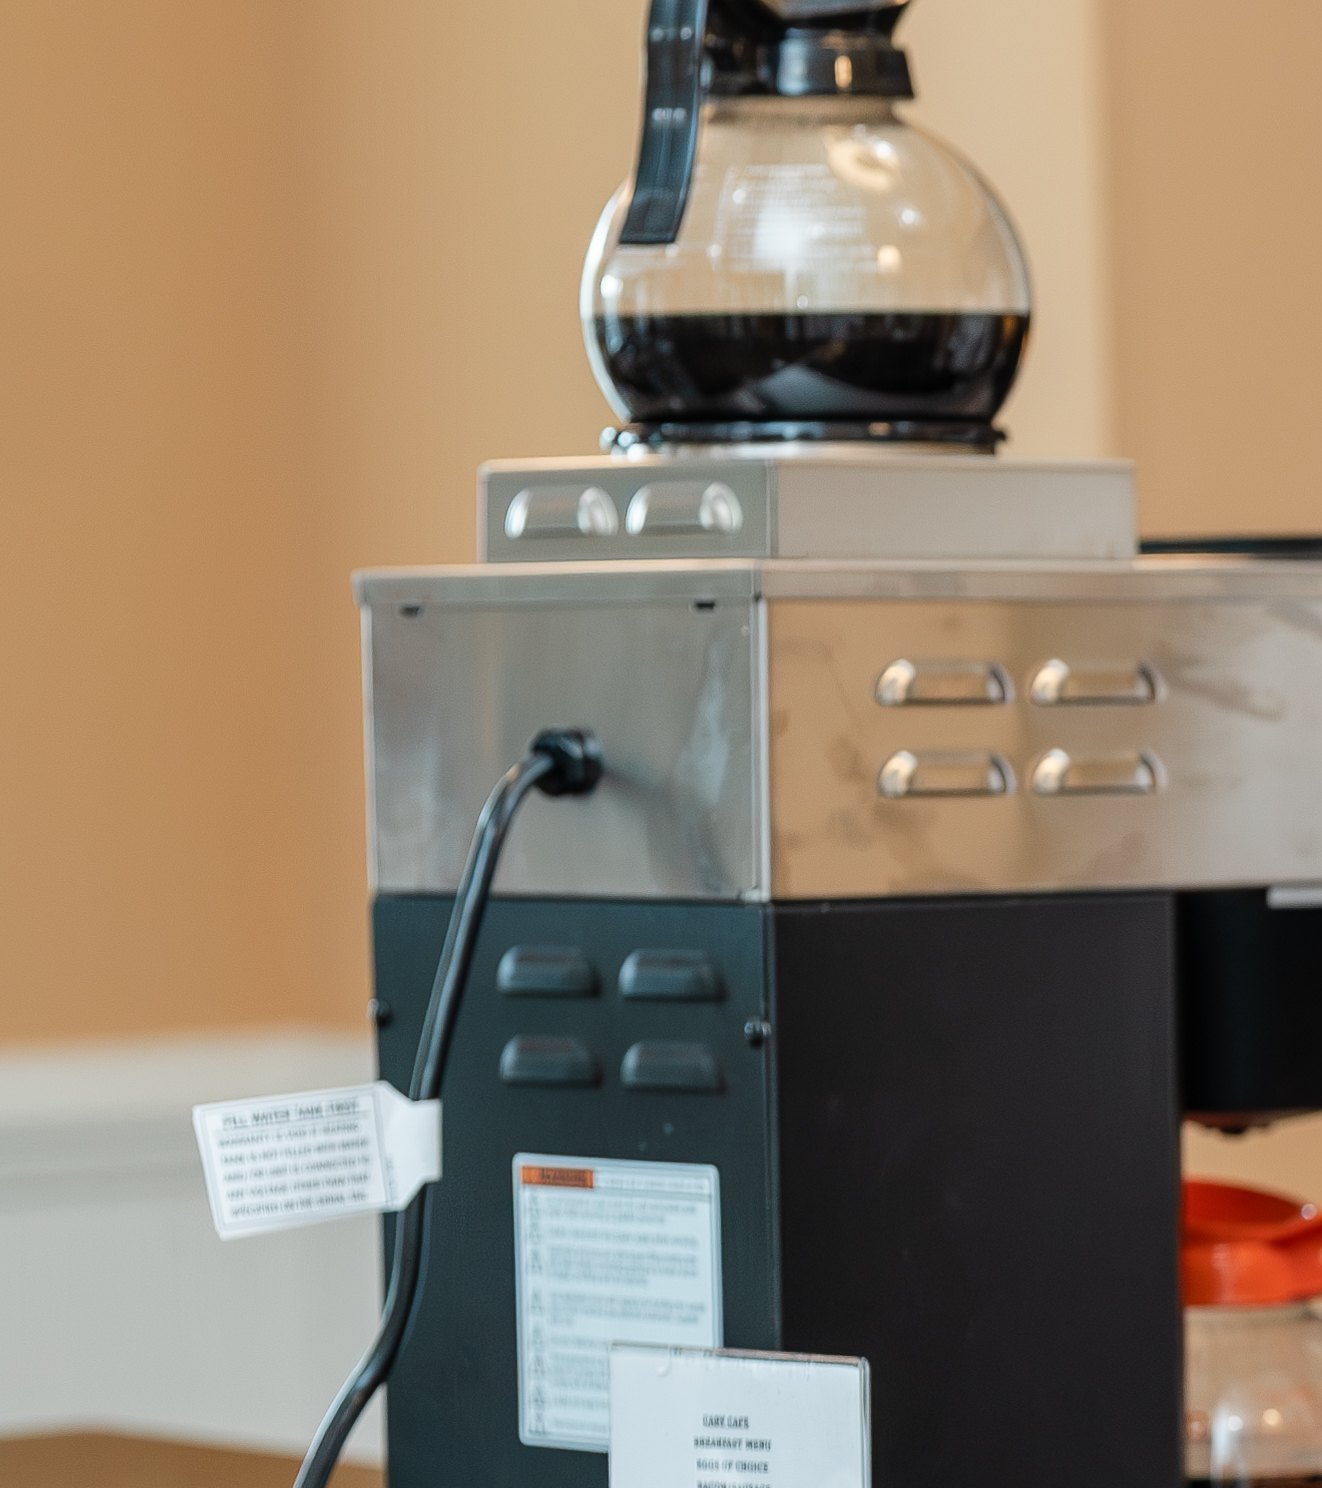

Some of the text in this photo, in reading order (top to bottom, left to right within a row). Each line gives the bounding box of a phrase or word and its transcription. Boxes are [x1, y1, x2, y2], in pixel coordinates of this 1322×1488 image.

[694, 1436, 772, 1452] BREAKFAST MENU
[736, 1460, 769, 1474] CHOICE
